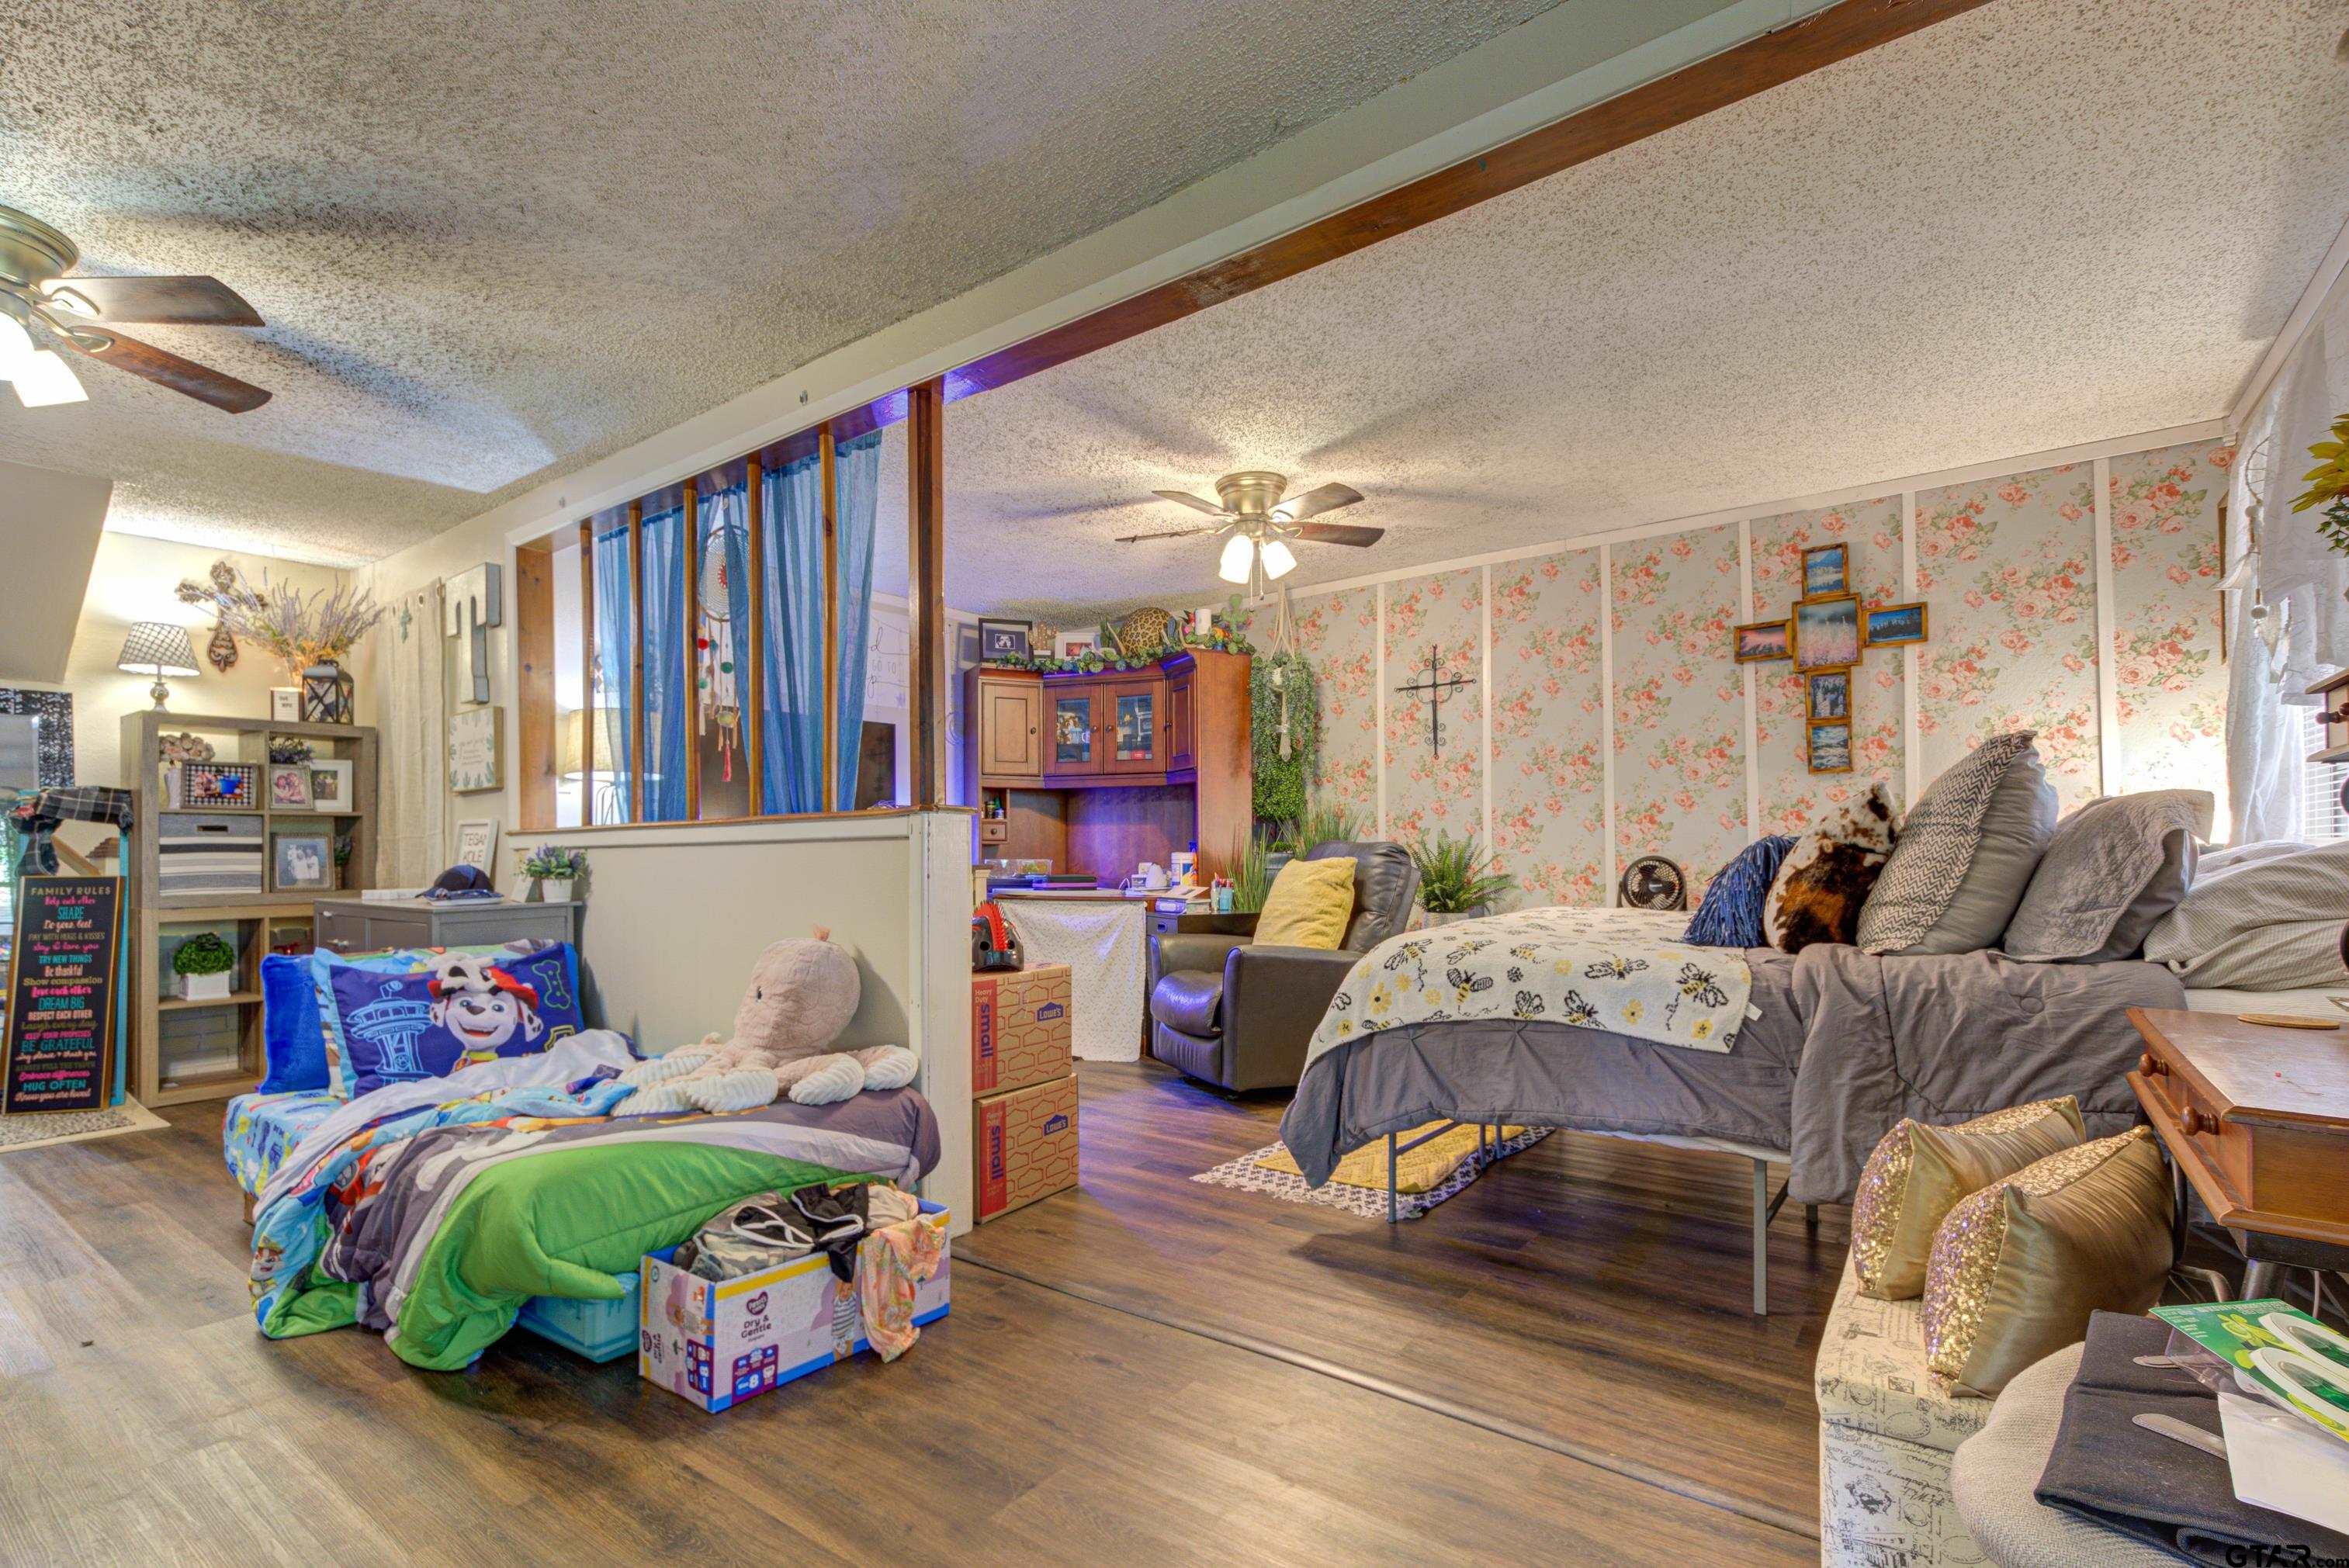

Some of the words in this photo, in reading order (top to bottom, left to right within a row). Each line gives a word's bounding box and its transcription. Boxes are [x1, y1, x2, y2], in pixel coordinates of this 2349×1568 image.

[31, 887, 72, 895] FAMILY
[77, 886, 111, 895] RULES
[57, 906, 85, 920] SHARE
[85, 932, 106, 940] KISSES
[53, 955, 68, 964] NEW
[69, 954, 92, 963] THINGS
[23, 978, 49, 986] Show
[50, 976, 102, 985] compassion
[38, 998, 70, 1010] DREAM
[70, 996, 85, 1009] BIG
[28, 1011, 55, 1021] RESPECT
[56, 1010, 72, 1019] EACH
[73, 1009, 93, 1019] OTHER
[981, 1004, 994, 1058] small
[21, 1040, 36, 1052] BE
[40, 1038, 95, 1051] GRATEFUL
[49, 1079, 87, 1090] OFTEN
[992, 1125, 1003, 1180] small
[744, 1318, 760, 1329] Dry
[741, 1323, 772, 1338] Gentle
